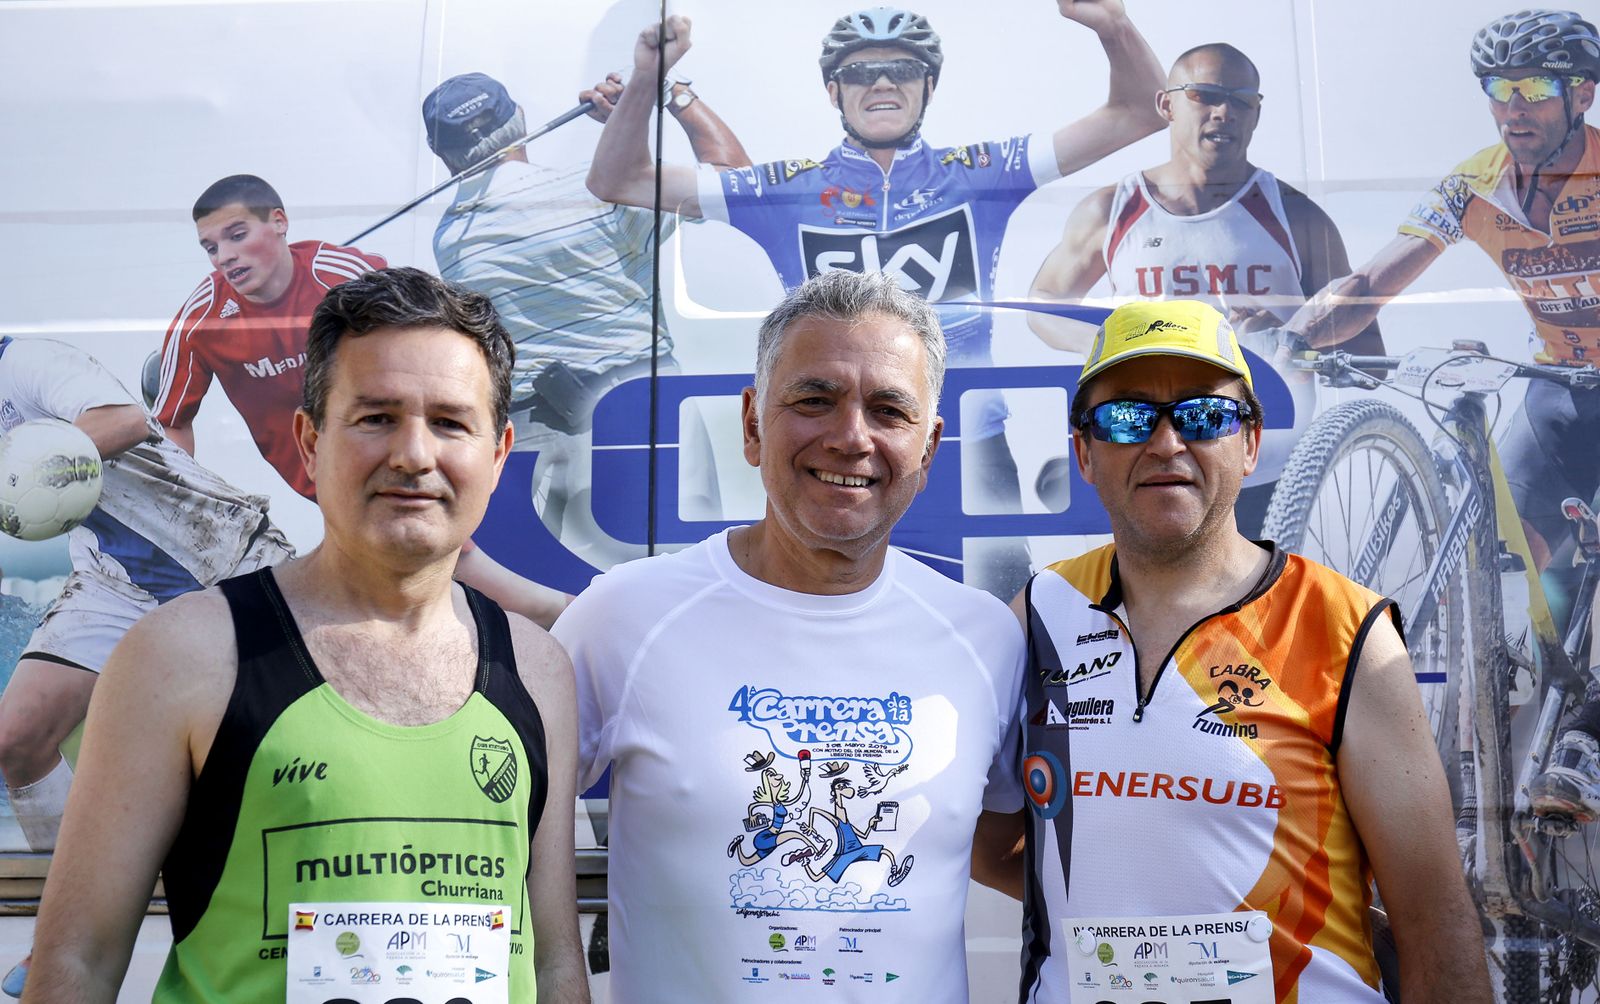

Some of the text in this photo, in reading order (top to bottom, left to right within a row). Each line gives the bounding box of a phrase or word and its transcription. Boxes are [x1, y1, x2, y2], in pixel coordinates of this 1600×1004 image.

[1135, 264, 1272, 298] USMC
[1209, 664, 1272, 690] CABRA
[750, 688, 888, 722] Carrera
[887, 692, 909, 708] de
[1064, 697, 1115, 718] aguilera
[779, 720, 898, 744] Prensa
[1192, 718, 1259, 740] running
[421, 880, 504, 901] Churriana
[323, 913, 404, 927] CARRERA
[408, 913, 428, 926] DE
[433, 914, 451, 927] LA
[454, 914, 491, 928] PRENS
[1150, 925, 1168, 937] DE
[1172, 924, 1191, 936] LA
[387, 931, 427, 950] APM
[794, 934, 817, 946] APM
[1134, 942, 1168, 959] APM
